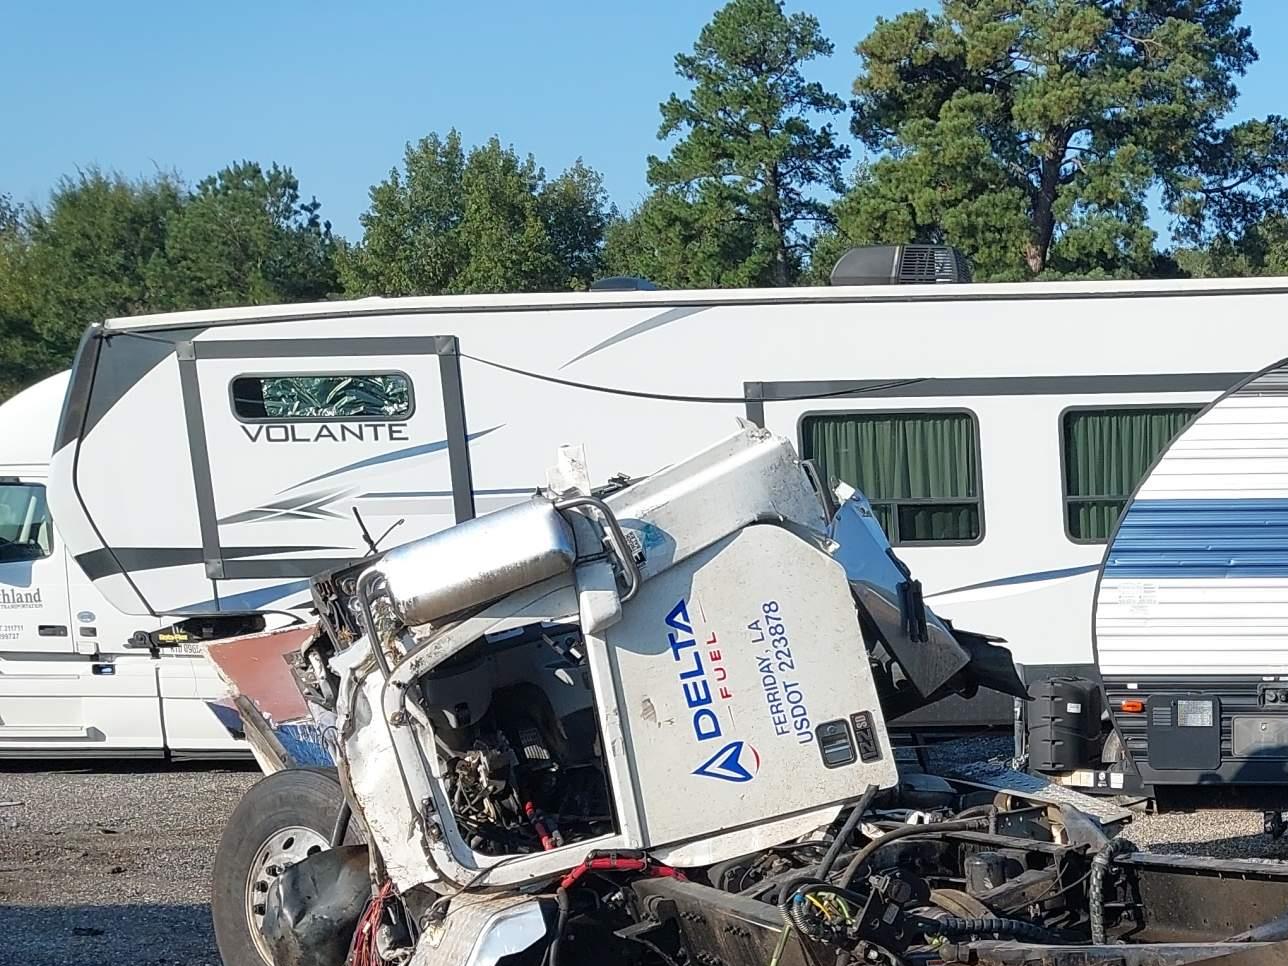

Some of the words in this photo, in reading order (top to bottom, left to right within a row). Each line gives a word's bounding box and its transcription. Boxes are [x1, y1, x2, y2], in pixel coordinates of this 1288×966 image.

[240, 423, 409, 442] VOLANTE
[0, 587, 42, 604] hland
[747, 619, 765, 644] LA
[763, 600, 795, 672] 223878
[664, 598, 722, 742] DELTA
[706, 632, 733, 700] FUEL
[755, 648, 790, 737] FERRIDAY,
[783, 680, 814, 745] USDOT
